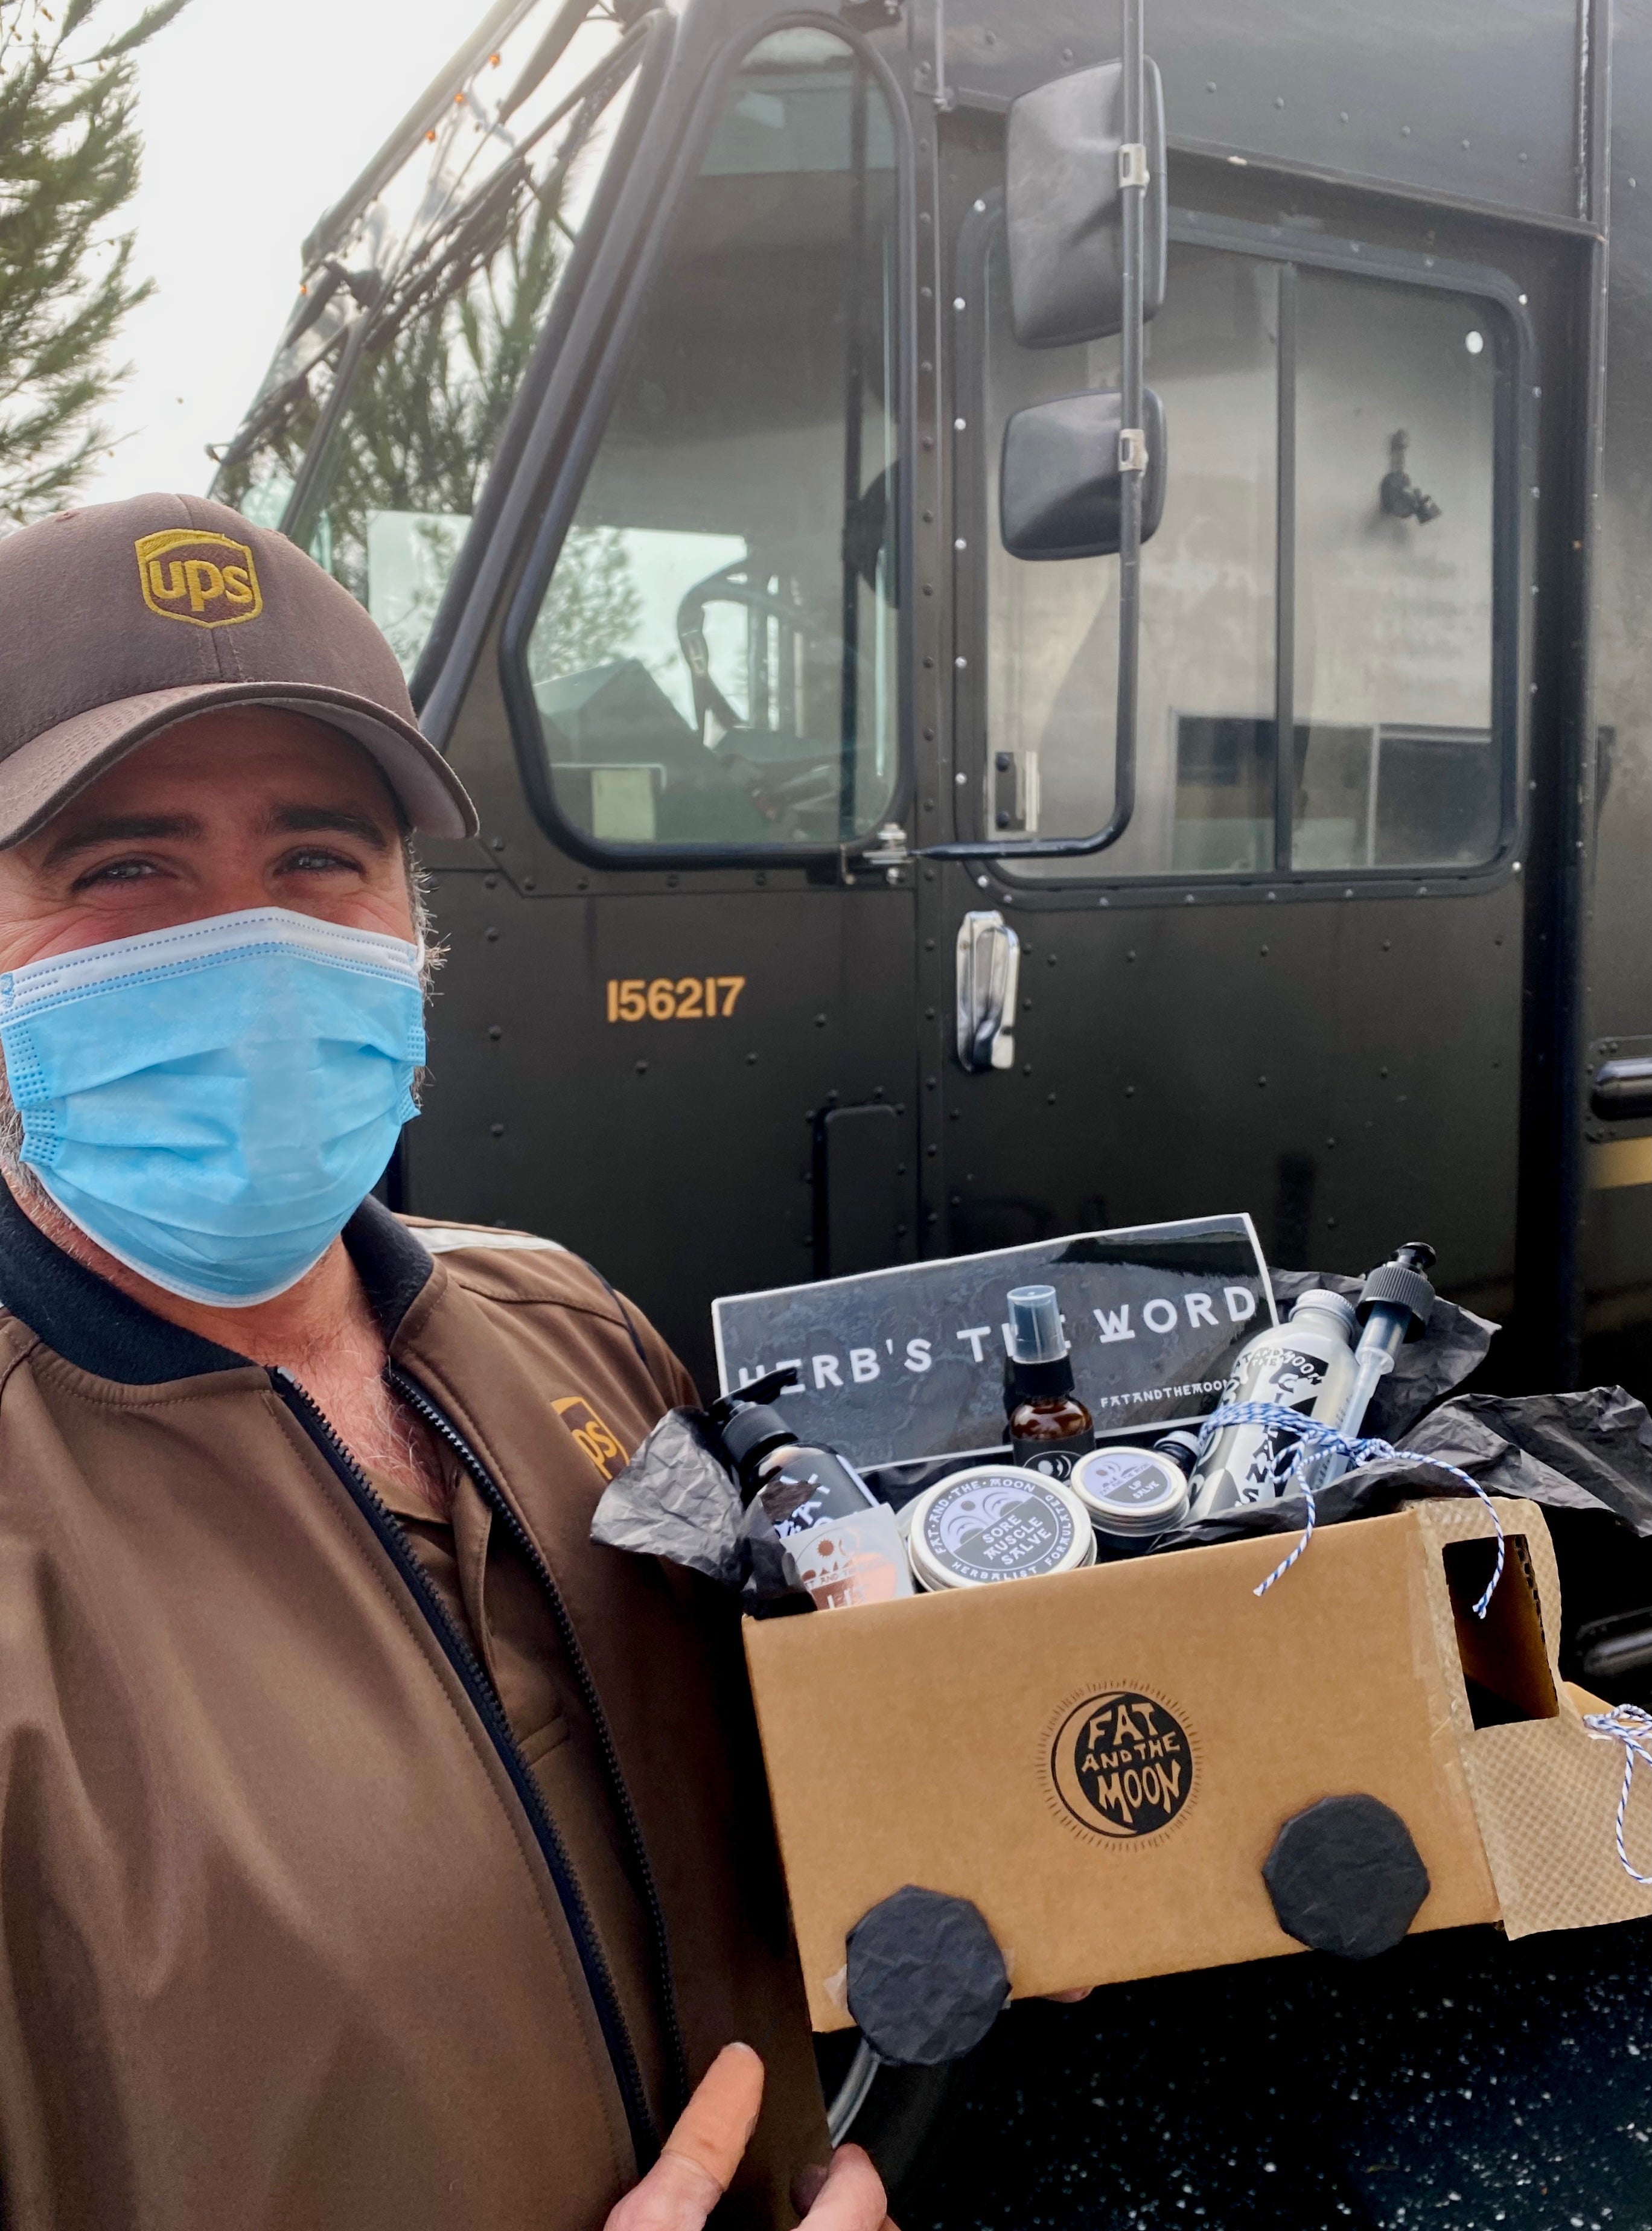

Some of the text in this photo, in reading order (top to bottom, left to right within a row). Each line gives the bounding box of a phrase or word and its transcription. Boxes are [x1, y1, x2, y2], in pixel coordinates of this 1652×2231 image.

[149, 560, 253, 611] ups
[607, 976, 745, 1023] 156217
[1094, 1286, 1257, 1342] WORD
[572, 1421, 617, 1479] ps
[927, 1478, 1036, 1555] FAT AND THE MOON
[951, 1494, 1073, 1581] HERBALIST FORMULATED
[982, 1514, 1022, 1543] SORE
[983, 1516, 1044, 1560] MUSCLE
[1001, 1528, 1052, 1566] SALVE
[1088, 1702, 1158, 1750] FAT
[1081, 1731, 1181, 1773] AND THE
[1097, 1758, 1181, 1824] MOON
